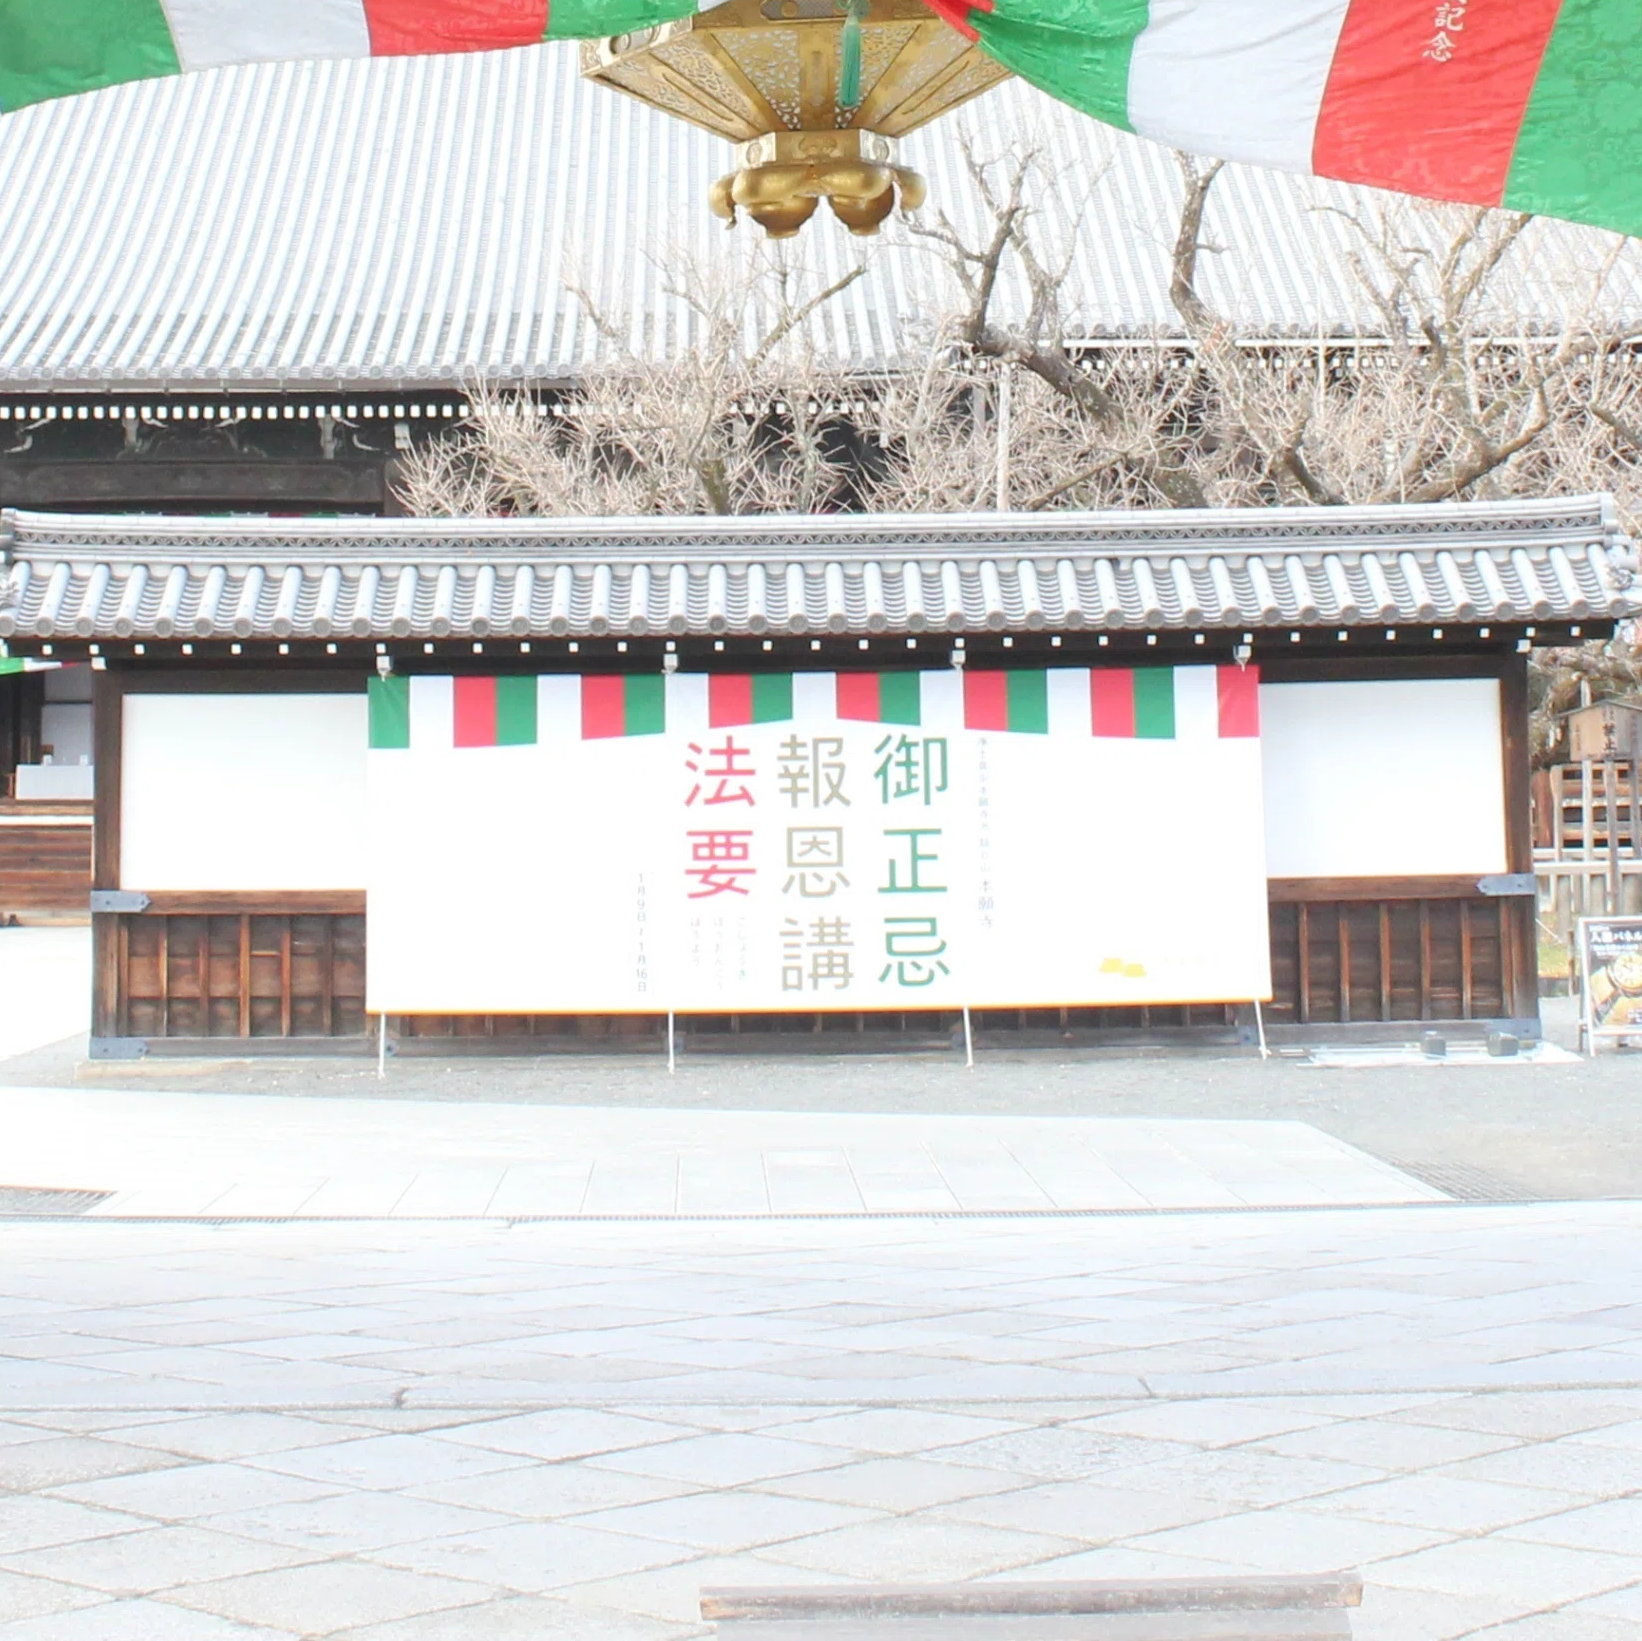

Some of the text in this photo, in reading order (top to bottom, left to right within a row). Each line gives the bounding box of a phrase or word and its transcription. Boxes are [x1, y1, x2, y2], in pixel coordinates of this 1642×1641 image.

[683, 735, 757, 899] 法要
[776, 734, 854, 991] 報恩講
[873, 733, 950, 987] 御正忌
